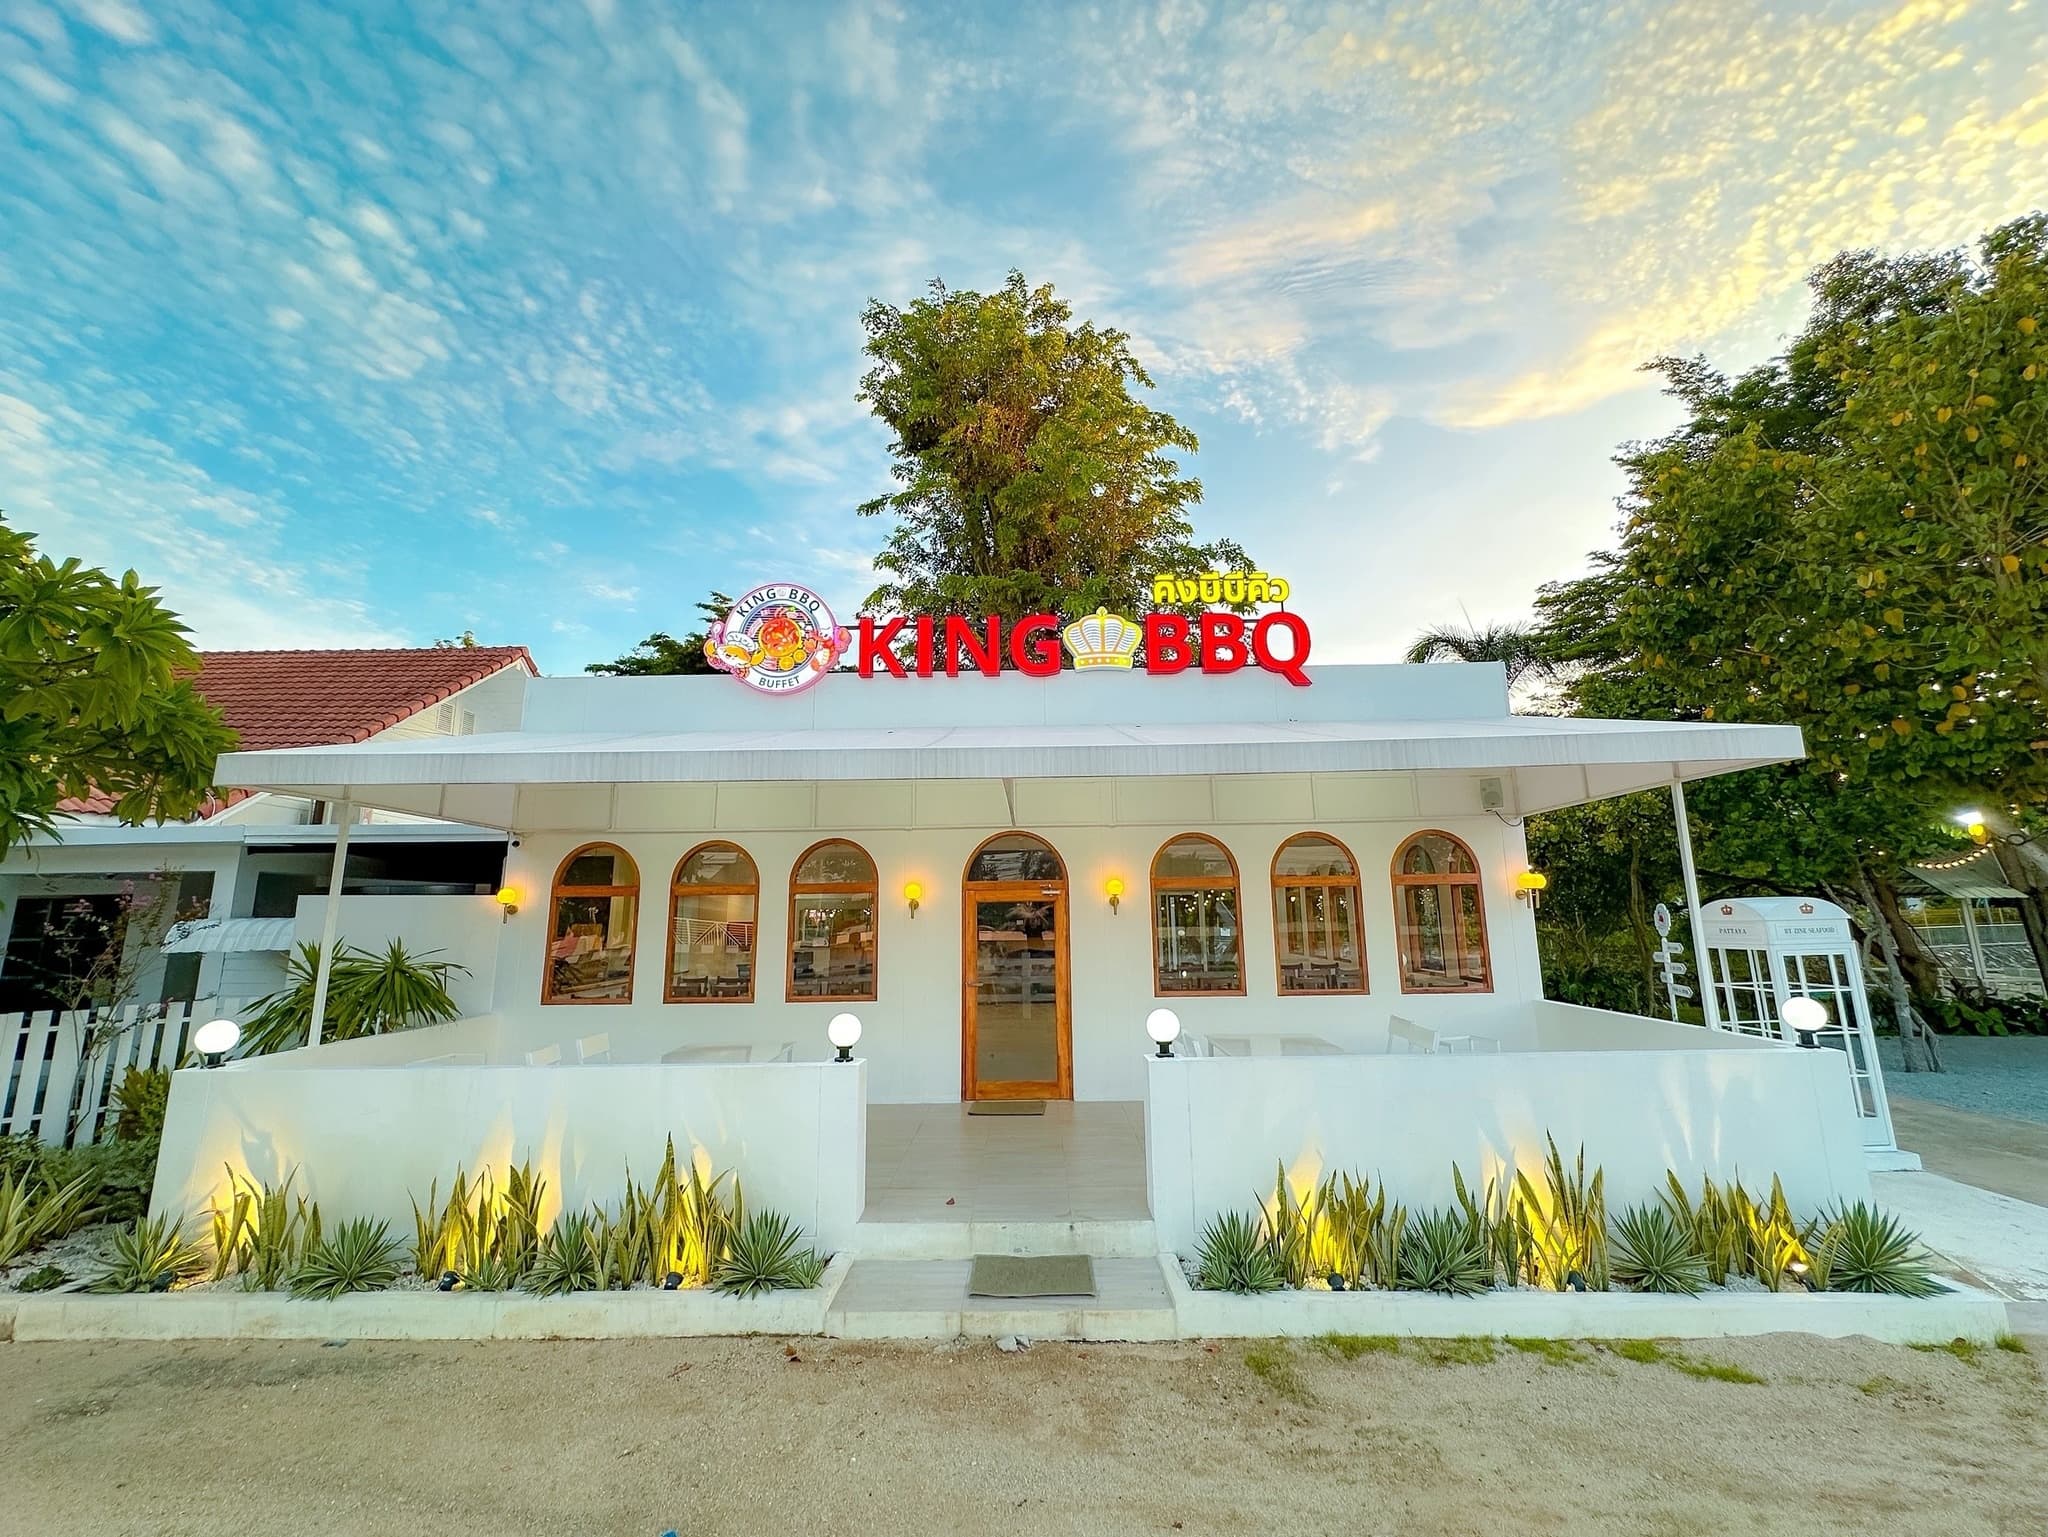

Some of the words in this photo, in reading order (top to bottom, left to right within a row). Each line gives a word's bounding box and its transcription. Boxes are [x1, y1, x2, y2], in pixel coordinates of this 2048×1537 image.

[736, 588, 777, 618] KING
[788, 588, 821, 614] BBQ
[858, 613, 1063, 679] KING
[1145, 611, 1313, 687] BBQ
[758, 675, 801, 688] BUFFET
